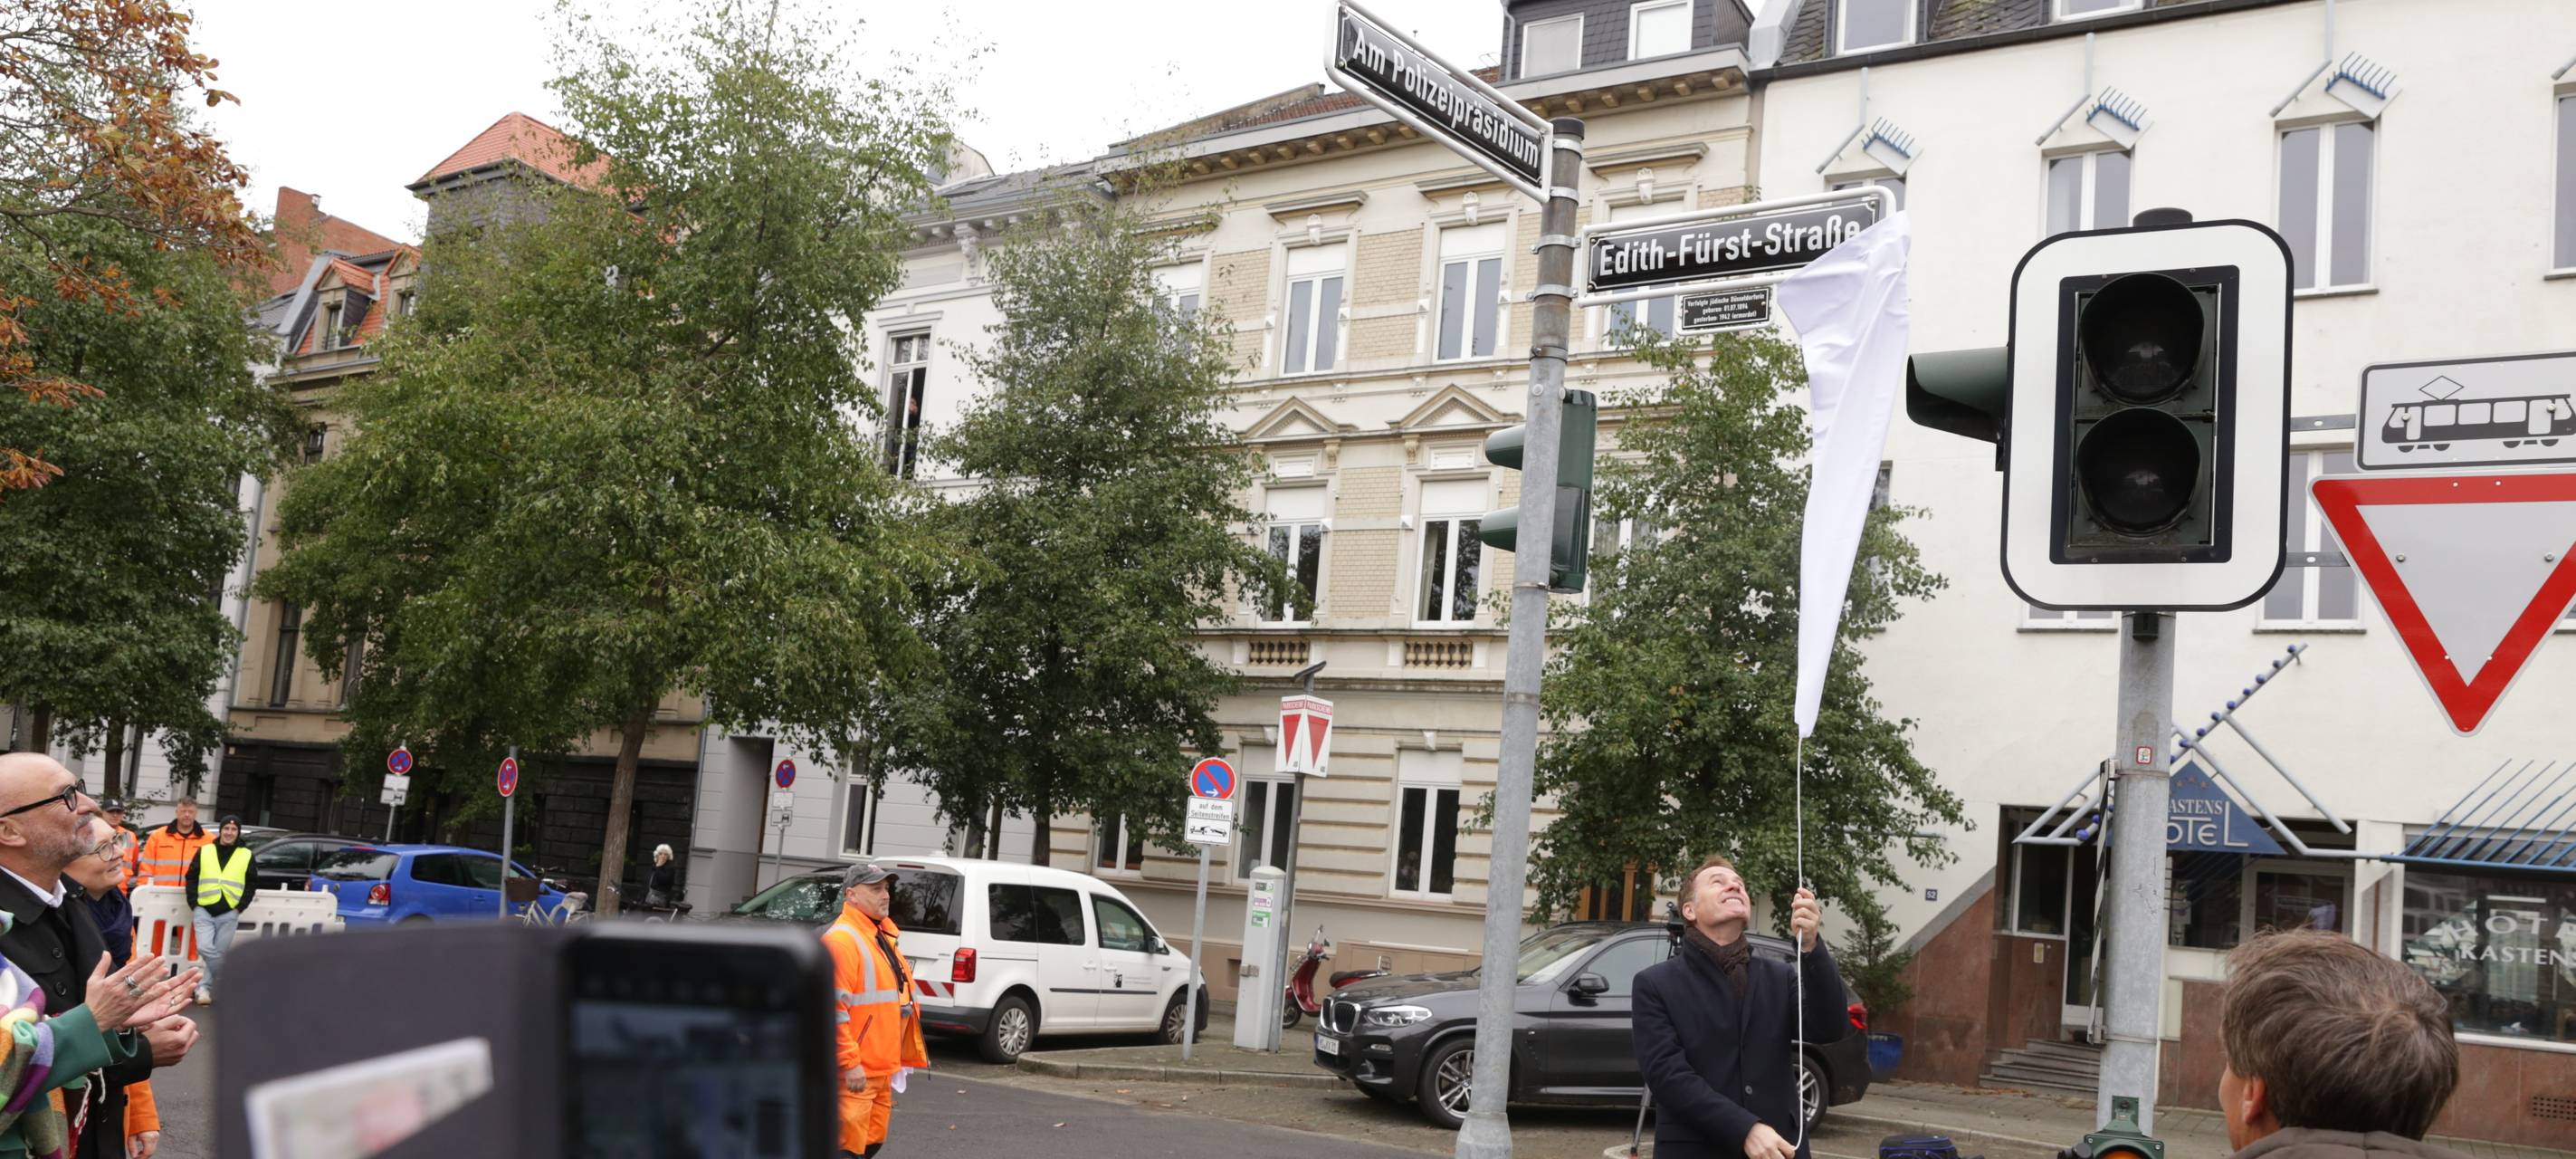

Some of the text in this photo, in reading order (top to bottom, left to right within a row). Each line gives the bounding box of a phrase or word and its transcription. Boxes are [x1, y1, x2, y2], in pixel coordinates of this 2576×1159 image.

[1353, 27, 1539, 168] Am Polizeipräsidium
[1598, 215, 1861, 277] Edith-Fürst-Straße
[1687, 293, 1765, 308] Verfolgte jüdische Düsseldorferin
[1732, 311, 1757, 320] (ermordet)
[1190, 809, 1230, 819] Seitenstreifen
[2168, 799, 2224, 815] ASTENS
[2166, 800, 2249, 848] OTEL
